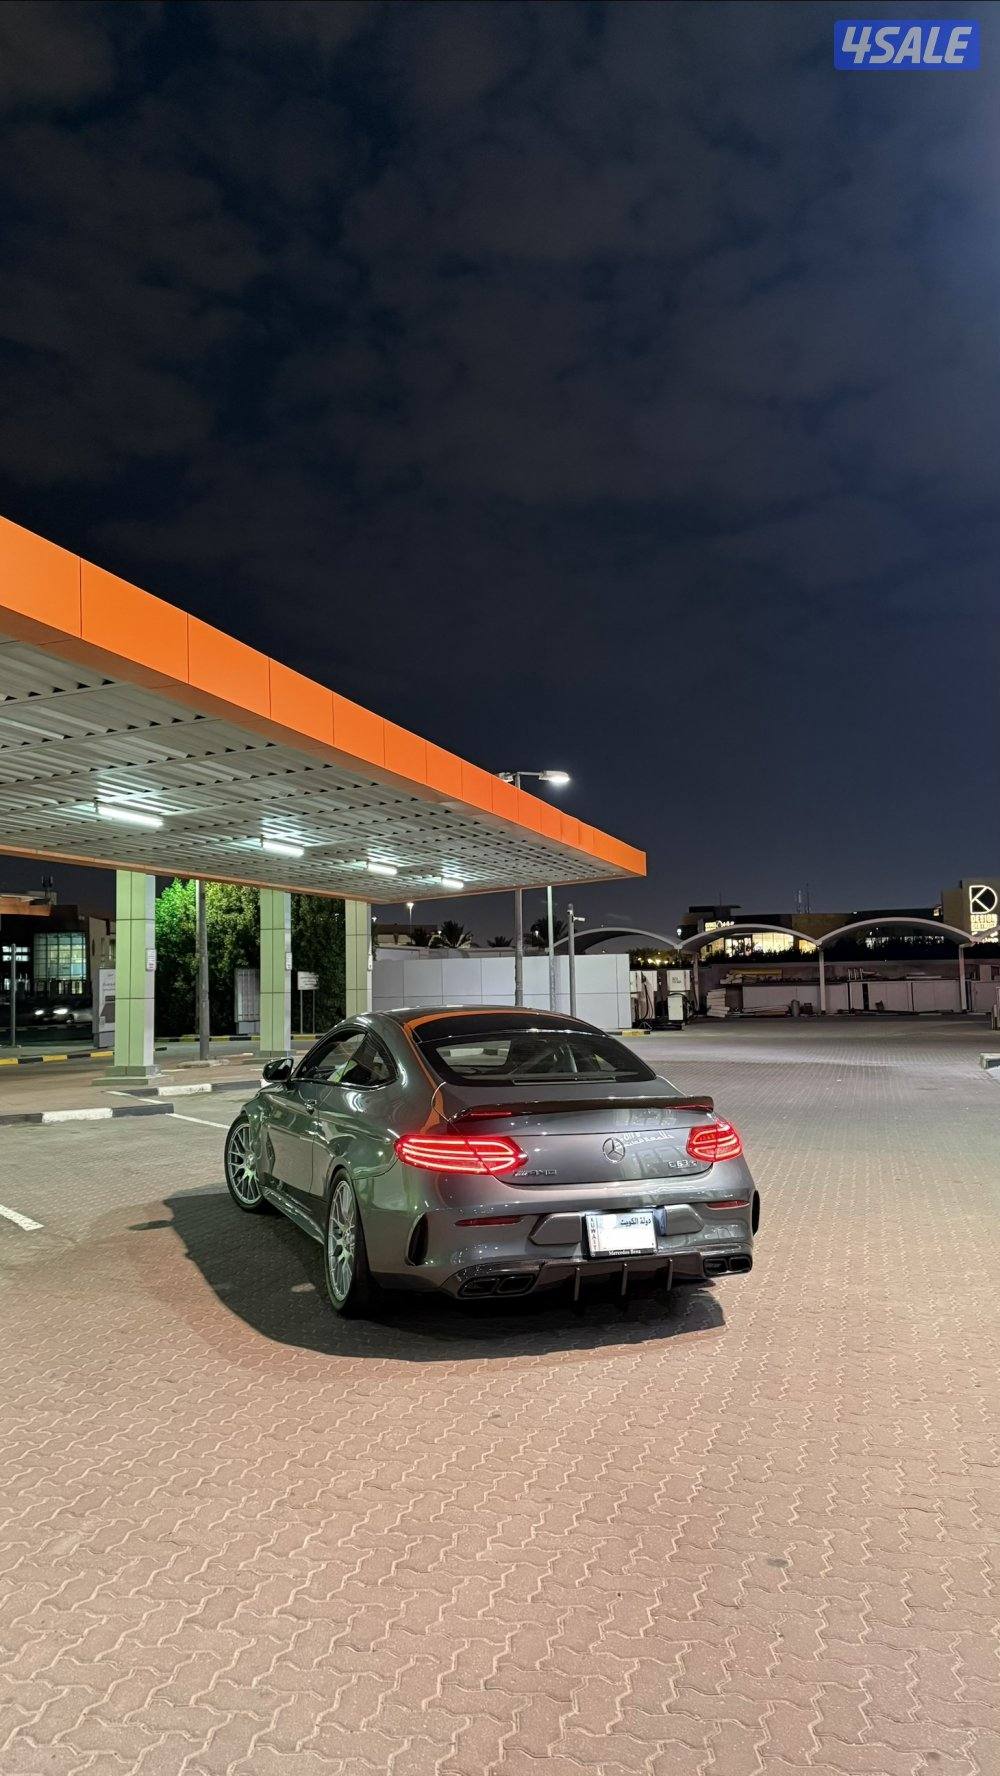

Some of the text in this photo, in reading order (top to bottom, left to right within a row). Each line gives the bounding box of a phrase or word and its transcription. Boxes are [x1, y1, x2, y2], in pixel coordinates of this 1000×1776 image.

[620, 1217, 651, 1227] دولة الكويت
[590, 1217, 598, 1251] KUWAIT
